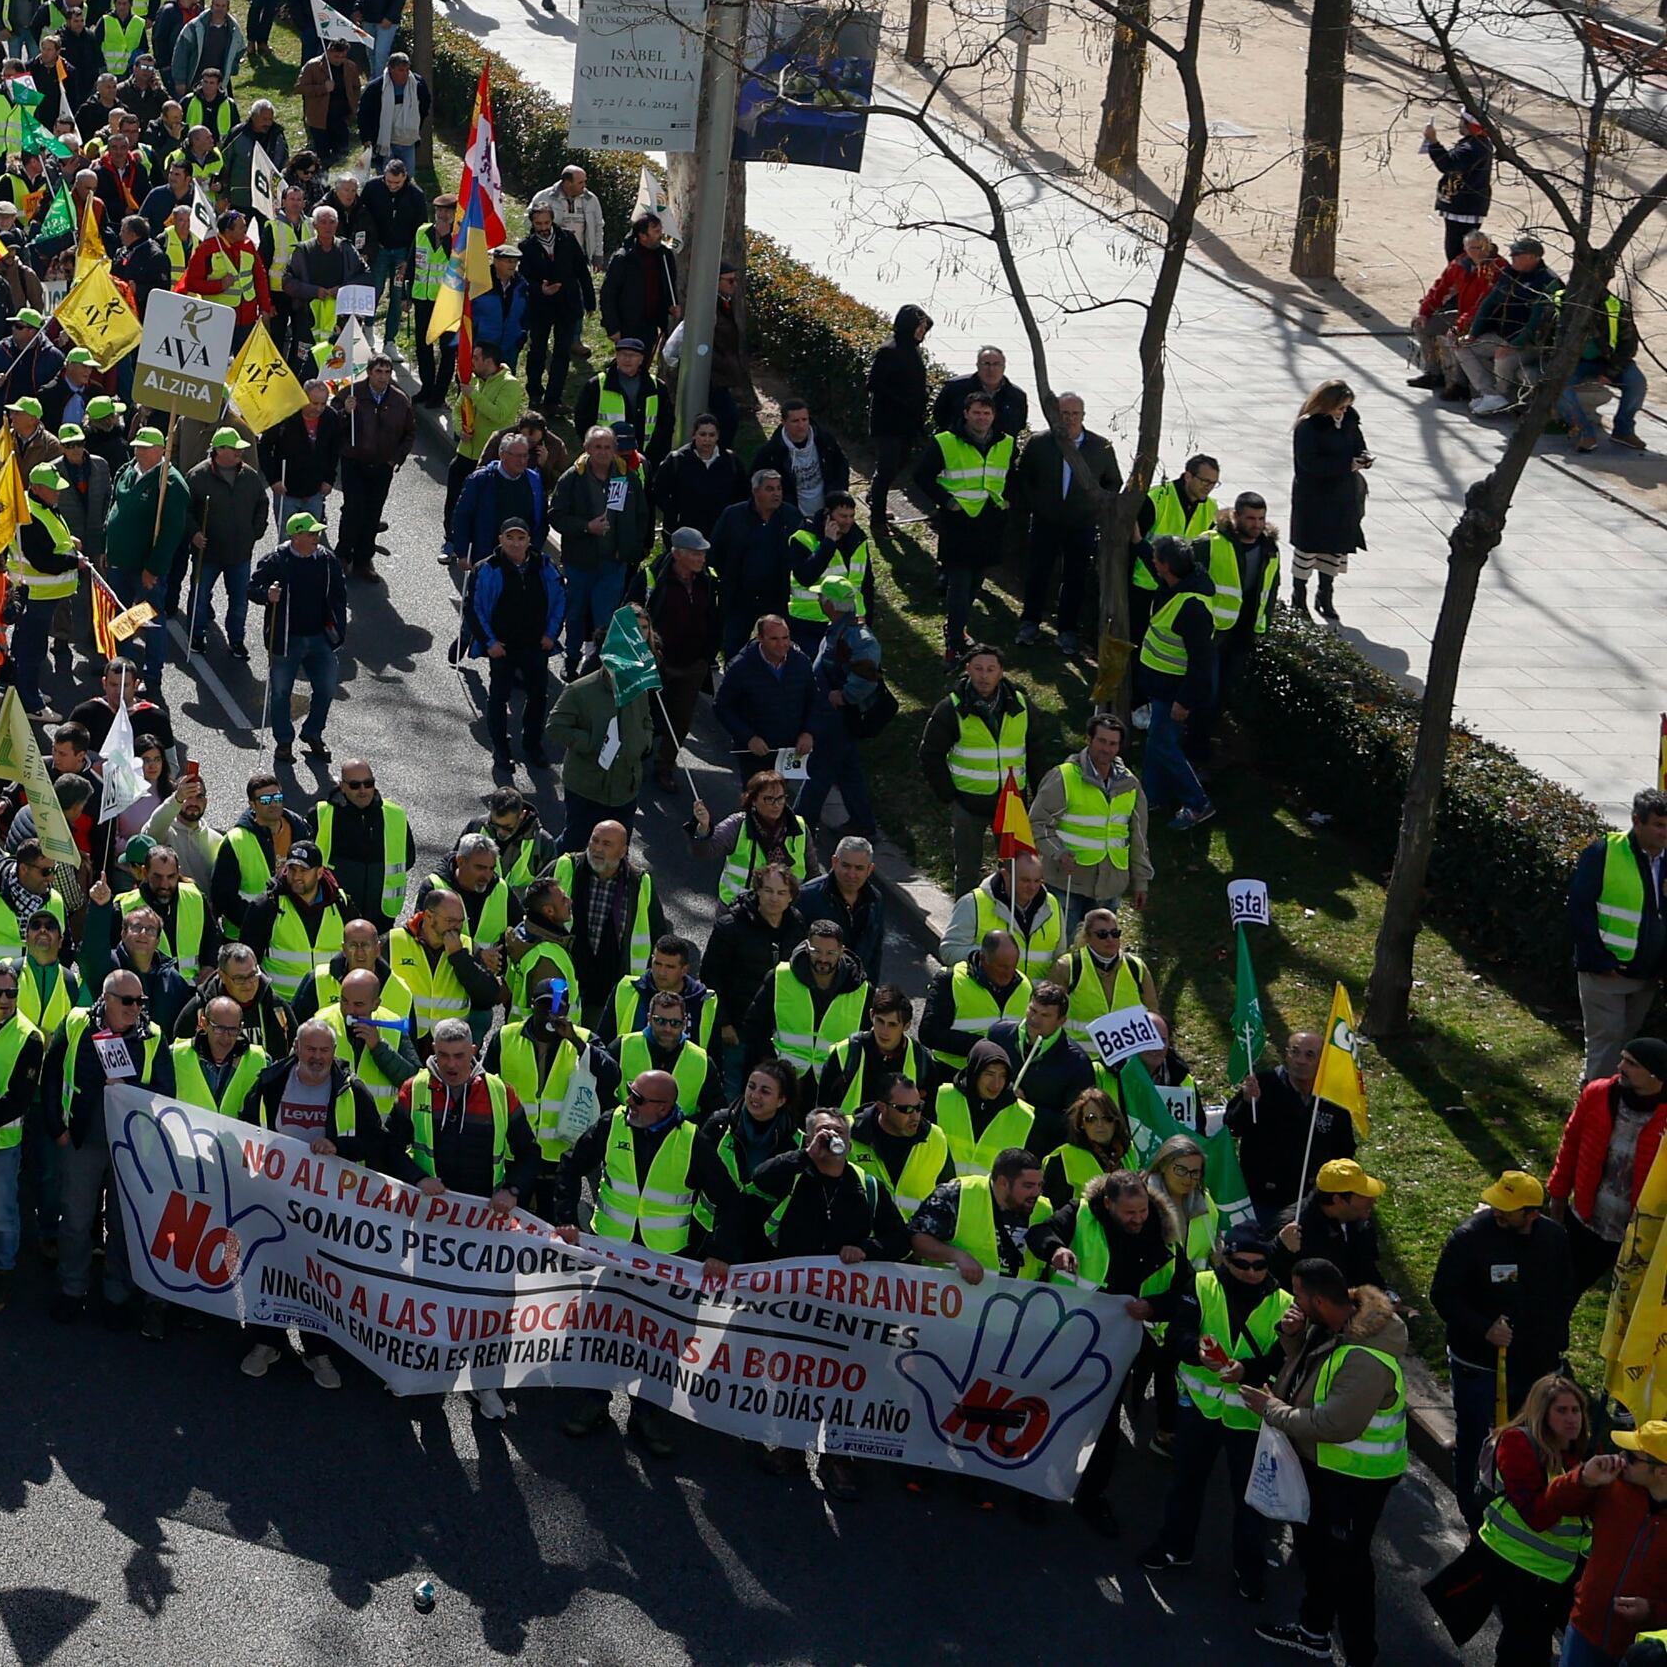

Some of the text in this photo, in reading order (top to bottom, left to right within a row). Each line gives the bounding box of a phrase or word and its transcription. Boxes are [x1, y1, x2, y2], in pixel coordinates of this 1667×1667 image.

[580, 66, 695, 82] QUINTANILLA
[611, 49, 666, 62] ISABEL
[592, 98, 615, 109] 27.2
[626, 98, 678, 110] 2.6.2024
[617, 136, 663, 146] MADRID
[156, 336, 211, 370] AVA
[143, 370, 211, 404] ALZIRA
[1095, 1015, 1157, 1058] Basta!
[150, 1190, 233, 1286] NO
[242, 1139, 963, 1319] NO AL PLAN DEL MEDITERRANEO
[286, 1199, 394, 1255] SOMOS
[402, 1228, 596, 1276] PESCADORES
[668, 1282, 920, 1350] DELINCUENTES
[306, 1256, 867, 1392] NO A LAS VIDEOCÁMARAS A BORDO
[260, 1265, 345, 1327] NINGUNA
[349, 1315, 440, 1372] EMPRESA
[446, 1347, 469, 1372] ES
[472, 1336, 577, 1368] RENTABLE
[580, 1335, 721, 1404] TRABAJANDO
[728, 1383, 767, 1413] 120
[772, 1386, 826, 1424] DÍAS
[830, 1396, 857, 1427] AL
[861, 1398, 911, 1434] AÑO
[940, 1377, 1050, 1459] NO
[847, 1443, 903, 1458] ALICANTE
